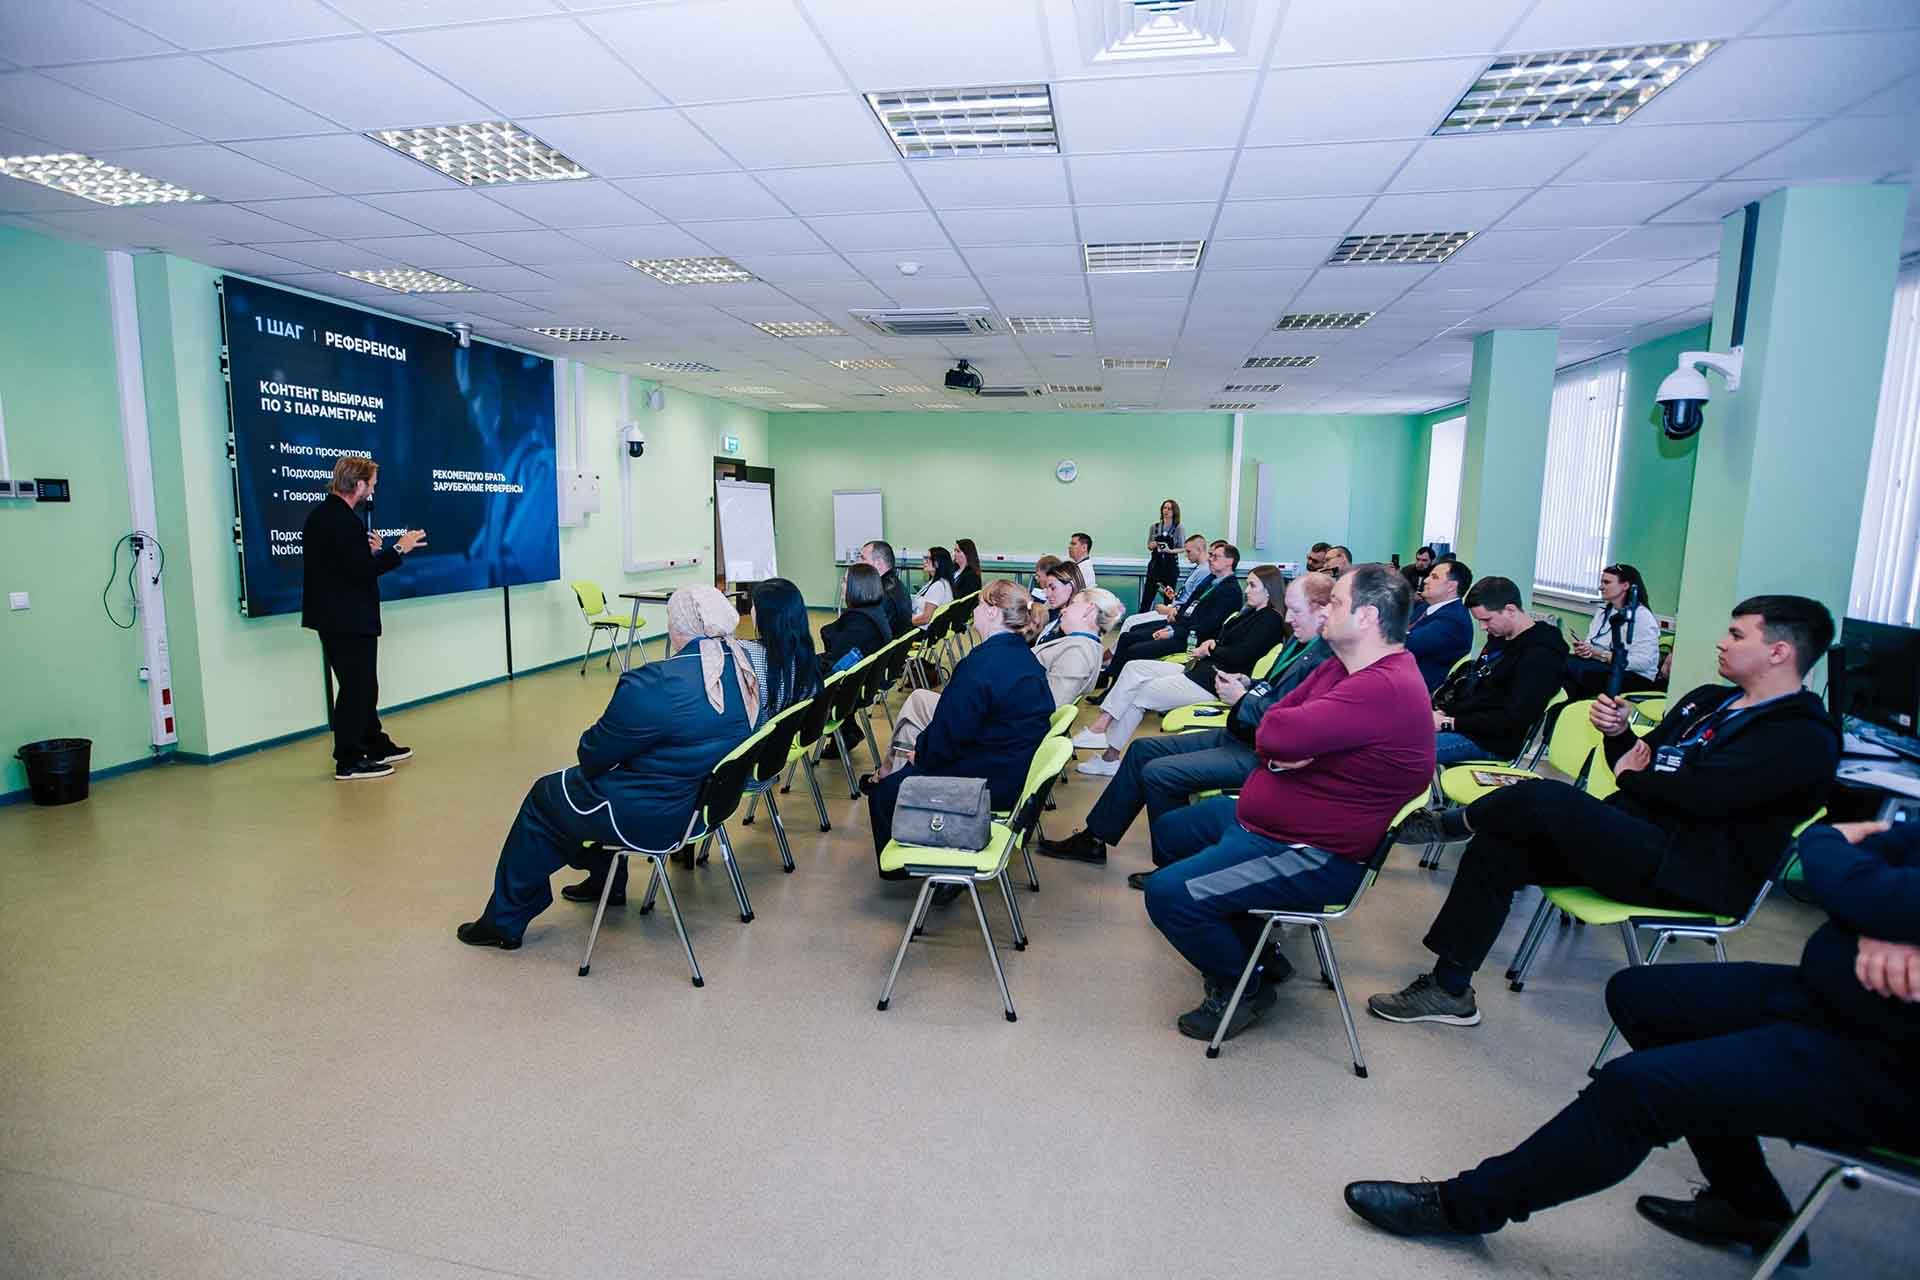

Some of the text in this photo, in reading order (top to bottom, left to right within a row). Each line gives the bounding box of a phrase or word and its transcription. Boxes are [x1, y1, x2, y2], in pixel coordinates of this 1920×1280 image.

[255, 315, 305, 340] 1 ШАГ
[325, 331, 407, 362] РЕФЕРЕНСЫ
[260, 380, 384, 410] КОНТЕНТ ВЫБИРАЕМ
[261, 397, 377, 423] ПО 3 ПАРАМЕТРАМ:
[280, 442, 373, 460] Много просмотров
[432, 469, 506, 482] РЕКОМЕНДУЮ БРАТЬ
[433, 481, 524, 494] ЗАРУБЕЖНЫЕ РЕФЕРЕНСЫ
